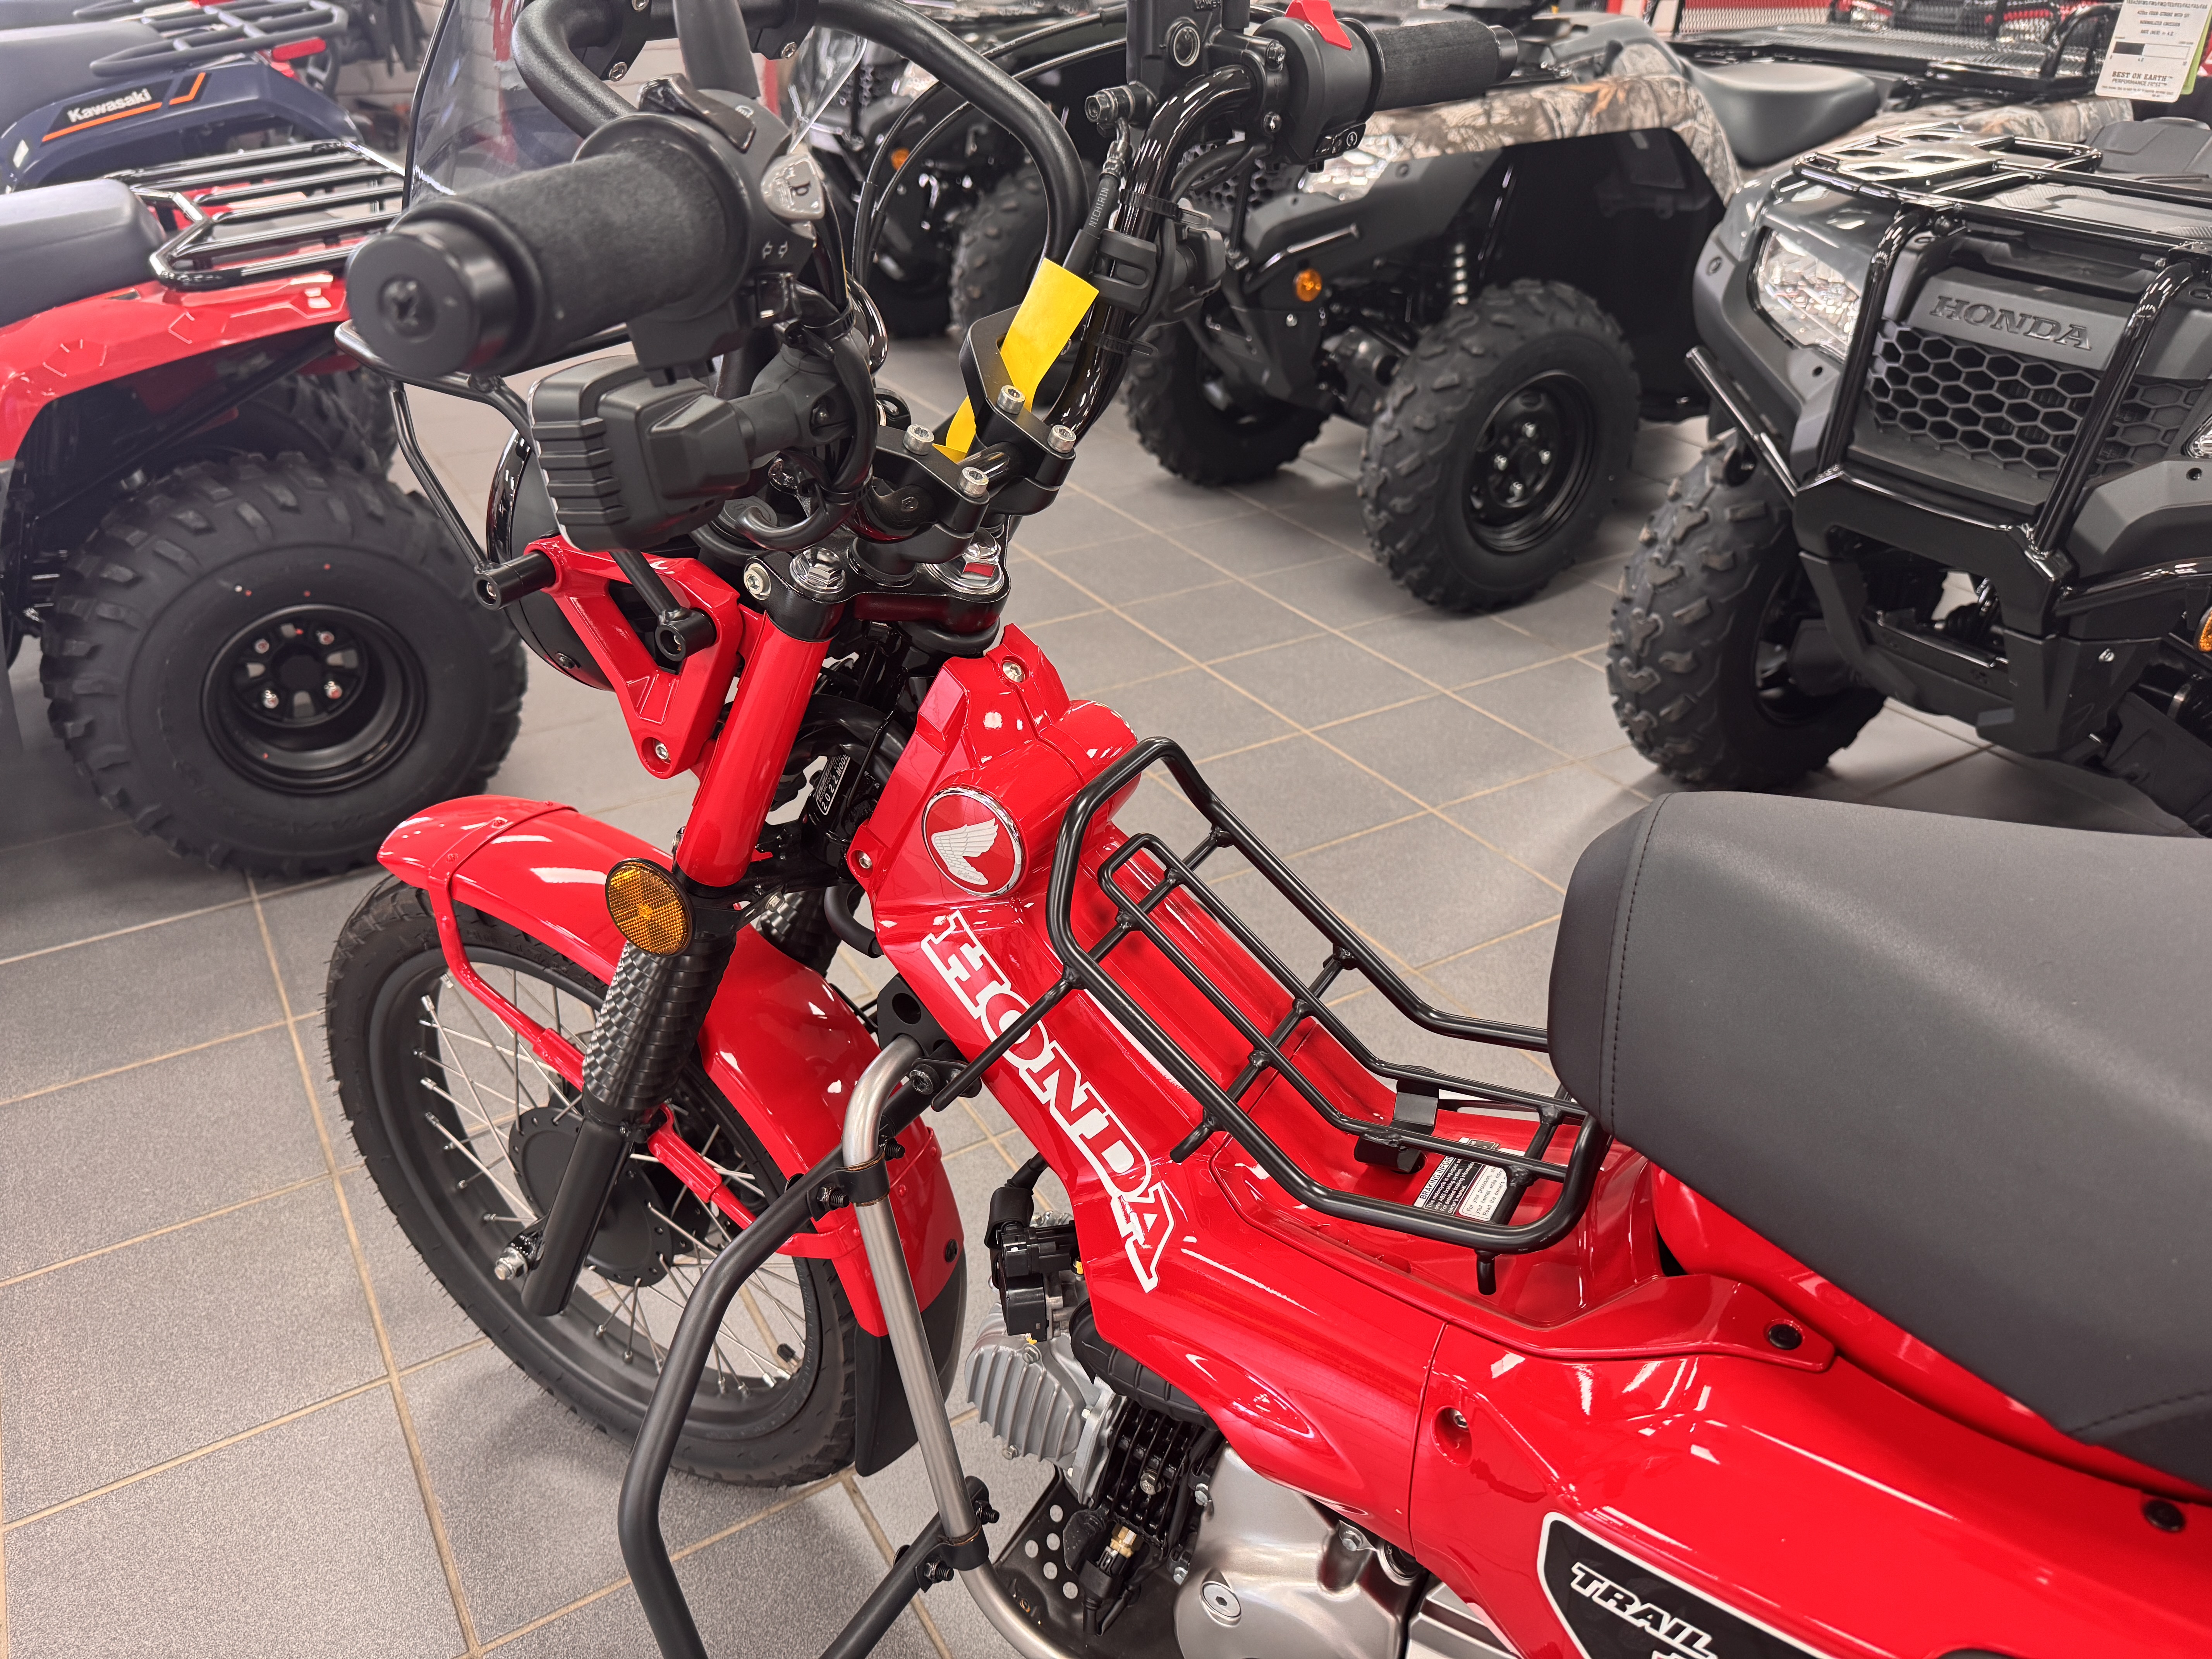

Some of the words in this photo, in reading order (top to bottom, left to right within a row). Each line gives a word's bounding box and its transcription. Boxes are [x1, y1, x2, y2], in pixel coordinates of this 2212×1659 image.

[67, 88, 152, 122] Kawasaki
[1089, 187, 1109, 227] NICHIRIN
[1929, 295, 2092, 351] HONDA
[836, 754, 848, 776] MODE
[921, 909, 1175, 1294] HONDA
[1420, 1174, 1440, 1199] BRAKING
[1426, 1200, 1435, 1208] This
[1433, 1181, 1446, 1200] motorcycle
[1438, 1193, 1447, 1202] ABS
[1443, 1180, 1456, 1194] braking
[1452, 1177, 1465, 1191] braking
[1482, 1205, 1492, 1216] Read
[1570, 1561, 1719, 1659] TRAIL
